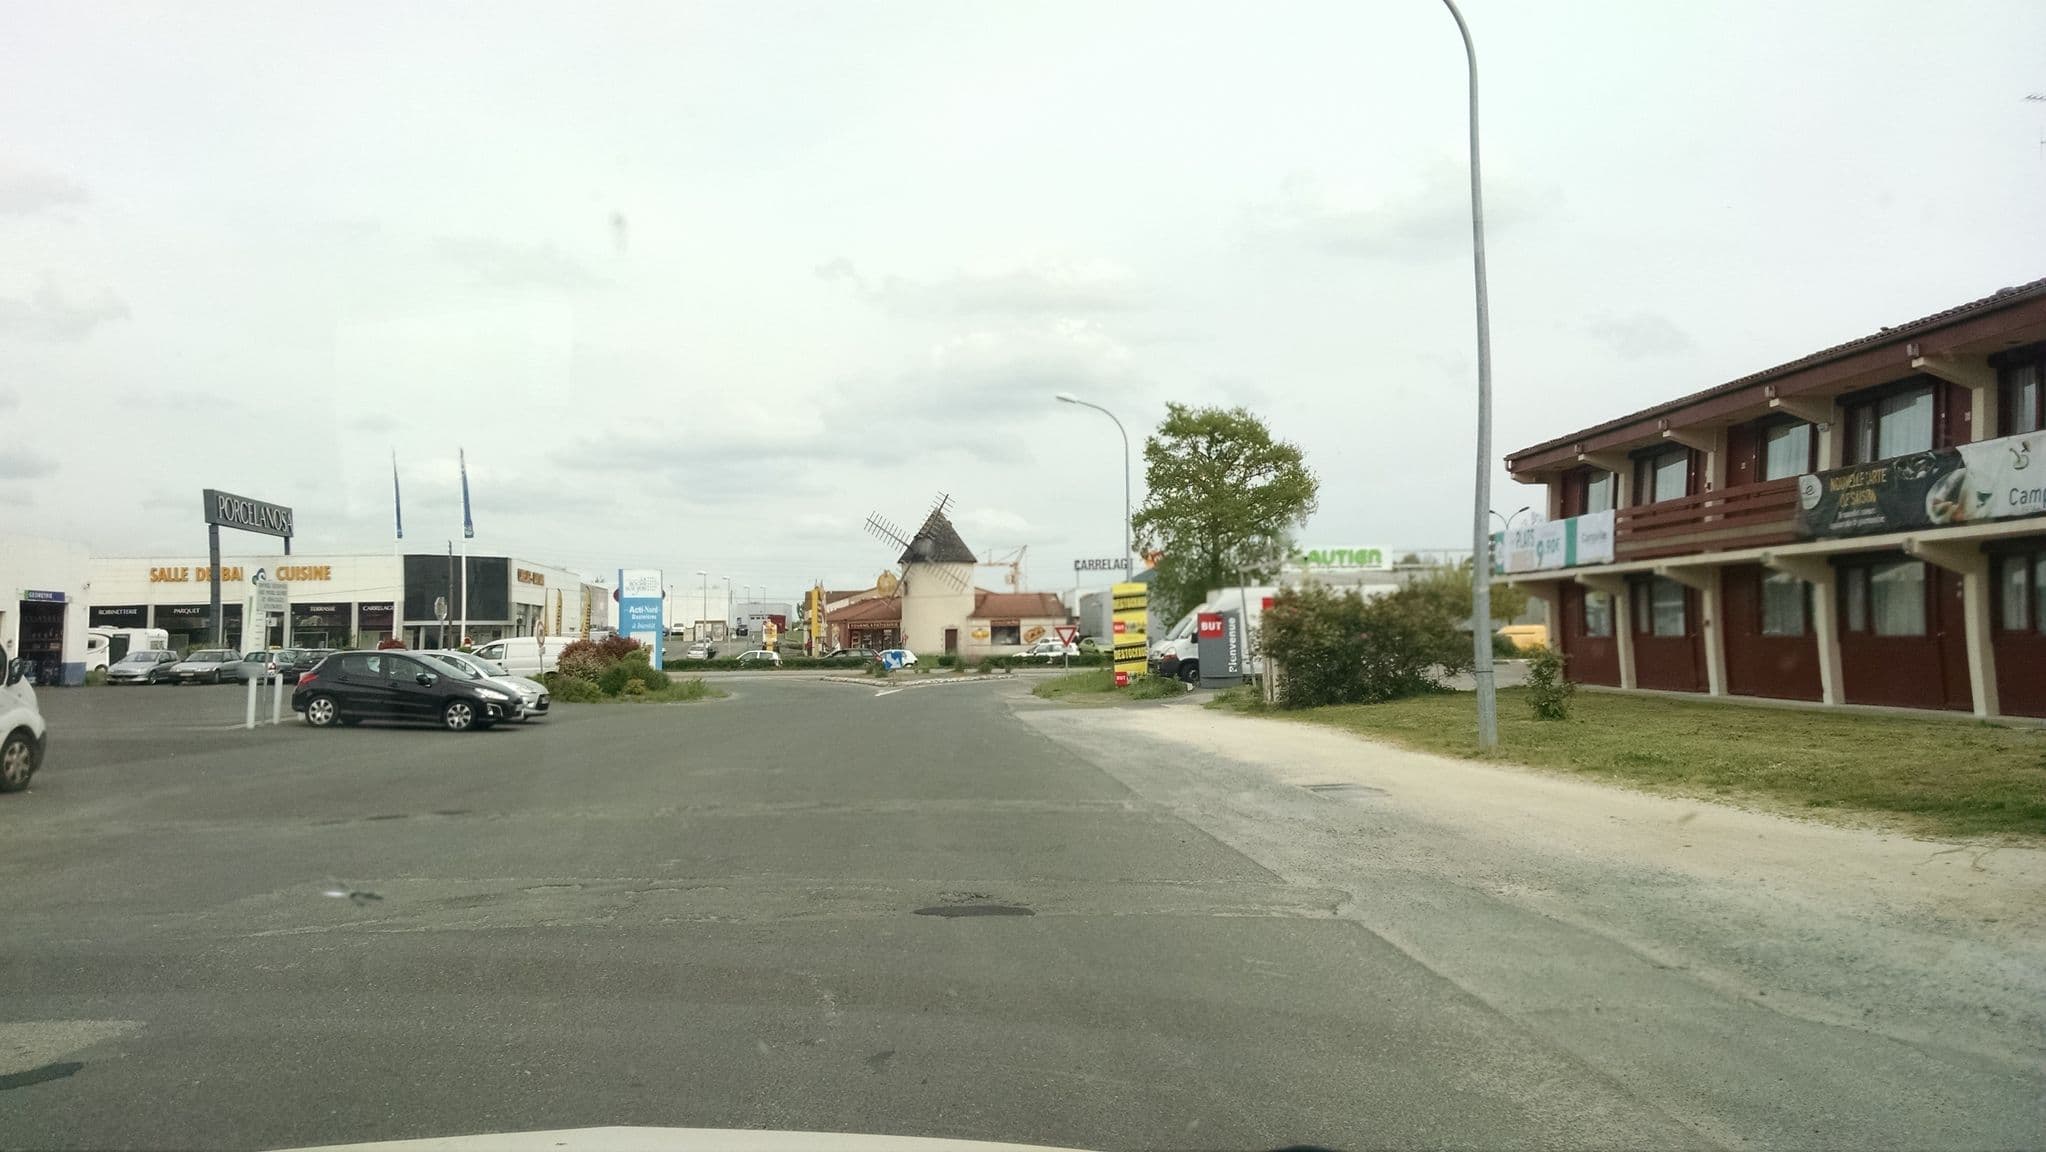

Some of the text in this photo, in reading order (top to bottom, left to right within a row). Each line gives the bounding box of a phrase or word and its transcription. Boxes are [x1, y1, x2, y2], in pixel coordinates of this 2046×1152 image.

[1074, 559, 1133, 570] CARRELAG
[150, 567, 189, 582] SALLE
[276, 566, 331, 581] CUISINE
[1200, 621, 1222, 631] BUT
[1228, 617, 1238, 673] Bienvenue
